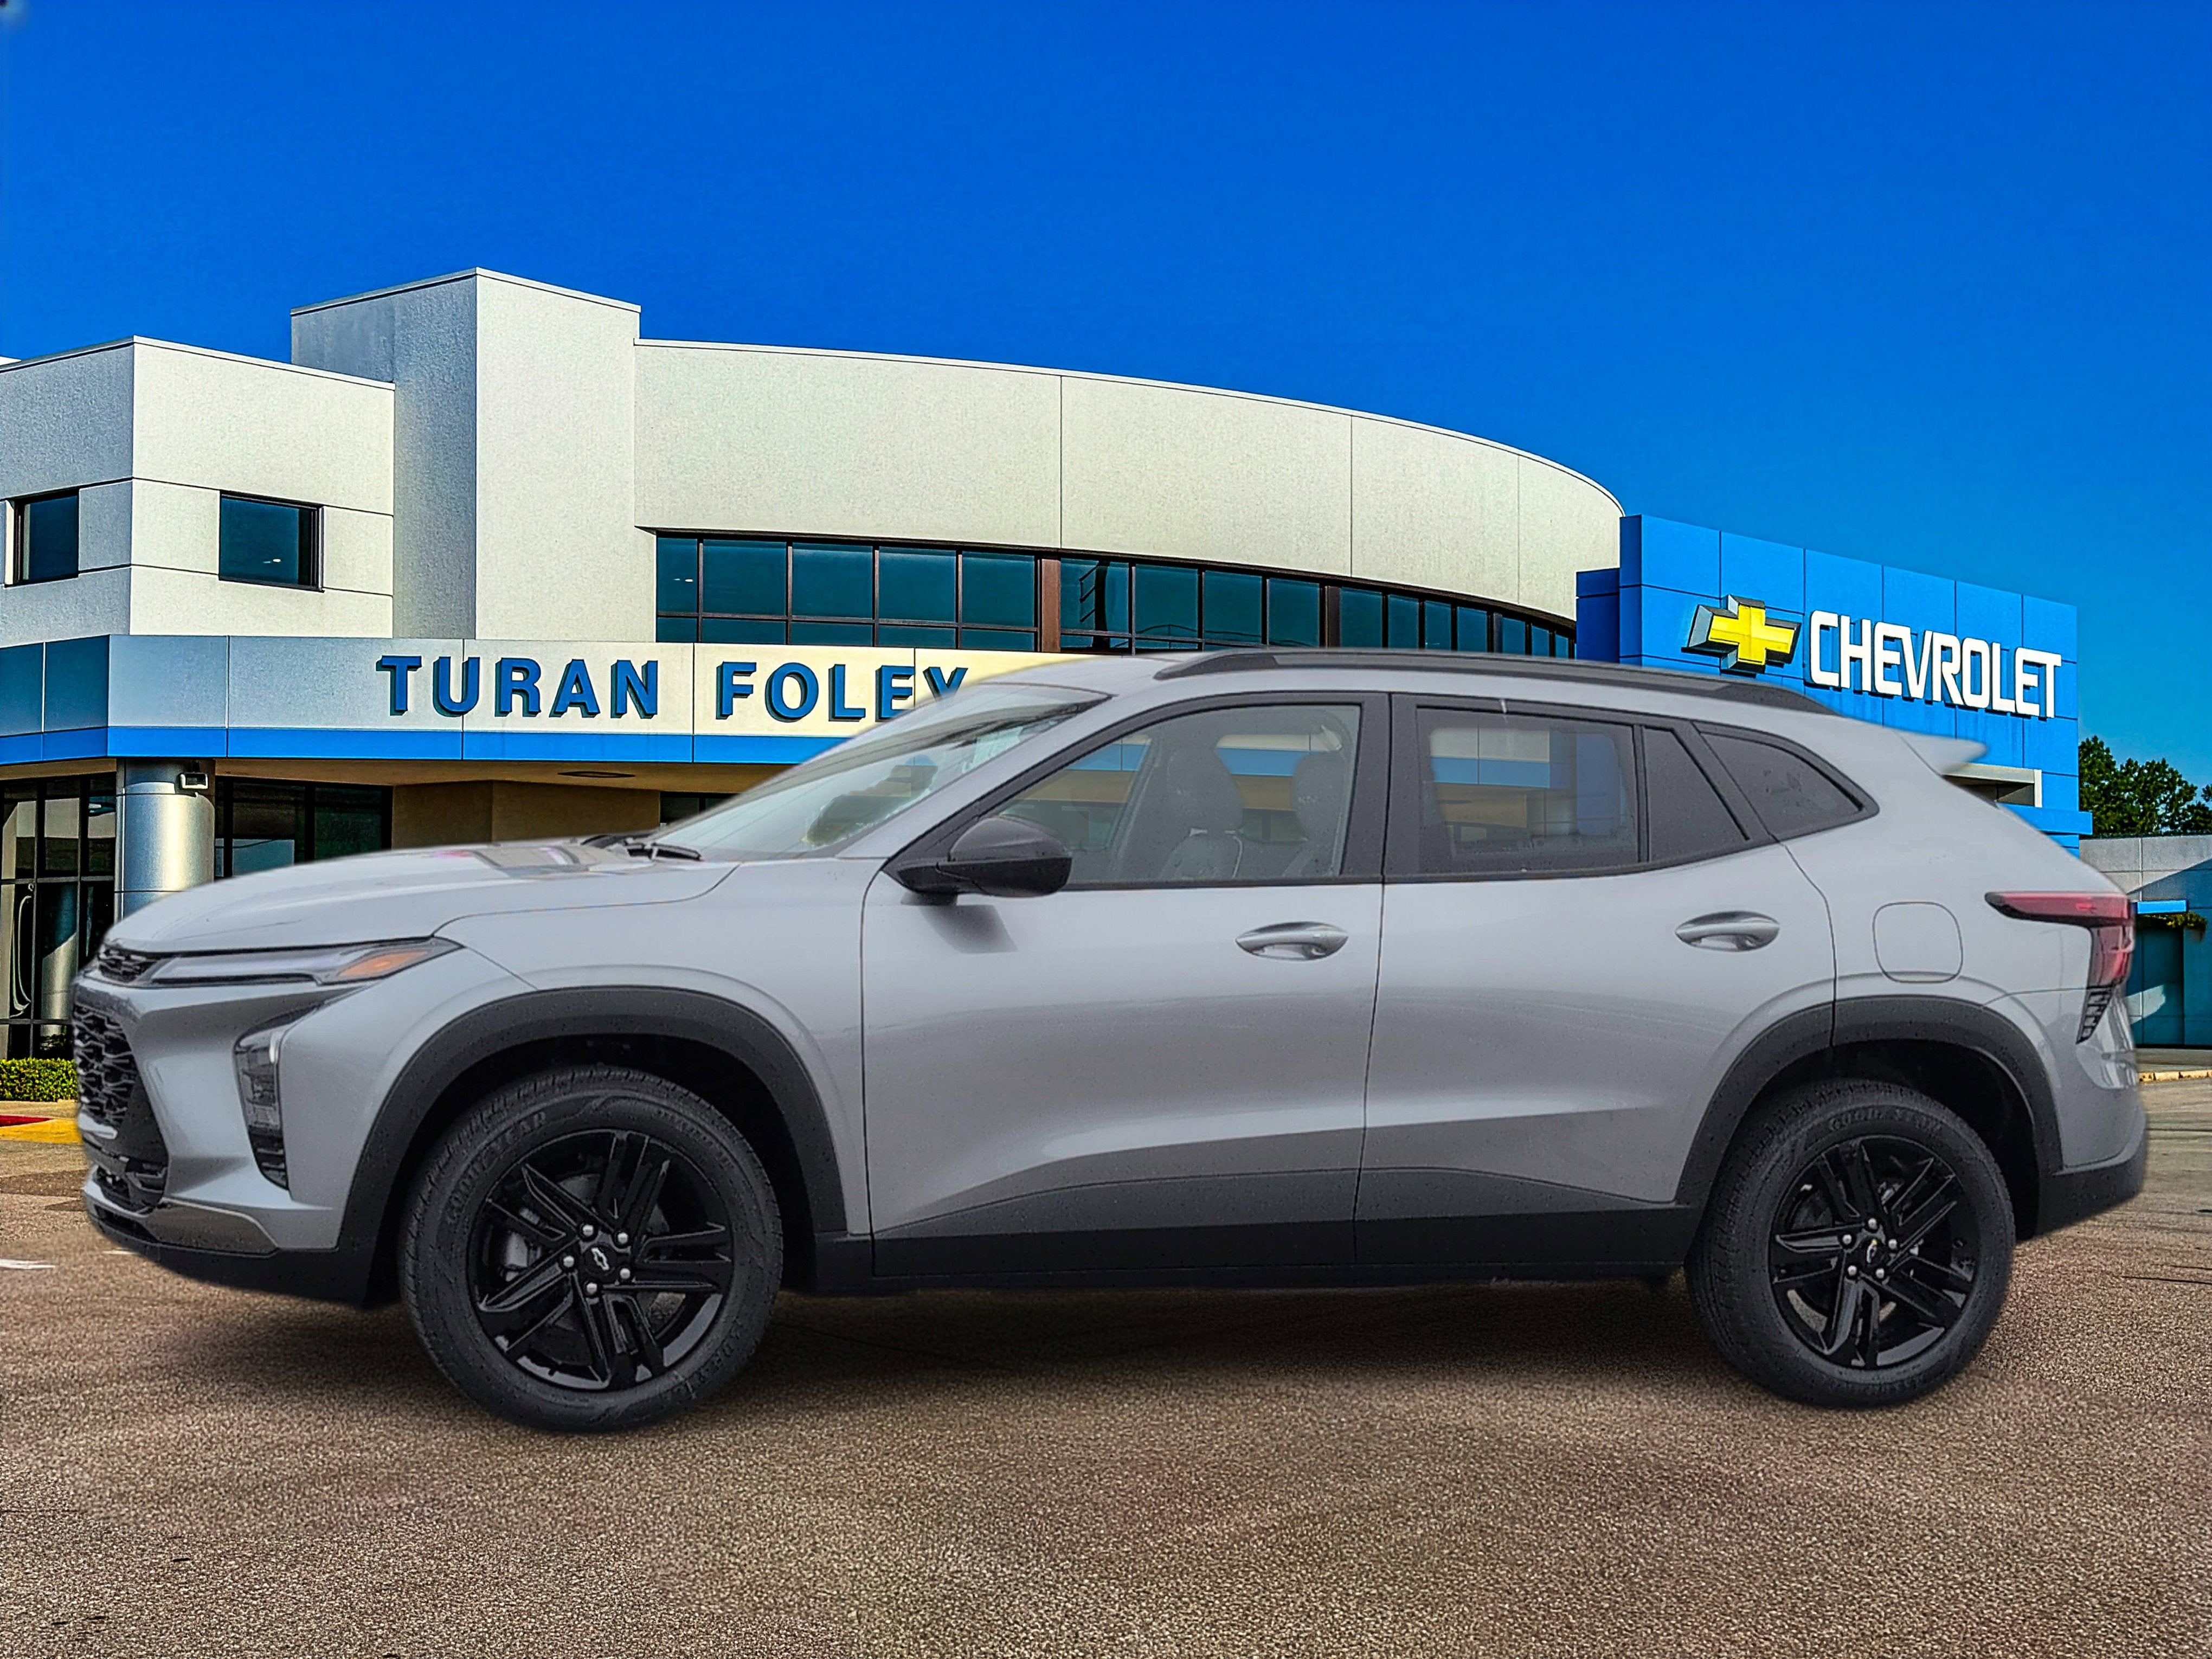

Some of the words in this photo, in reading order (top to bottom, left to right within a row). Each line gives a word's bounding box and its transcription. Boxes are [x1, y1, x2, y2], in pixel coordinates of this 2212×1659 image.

[377, 655, 658, 718] TURAN
[716, 661, 969, 722] FOLEY
[1810, 610, 2062, 718] CHEVROLET
